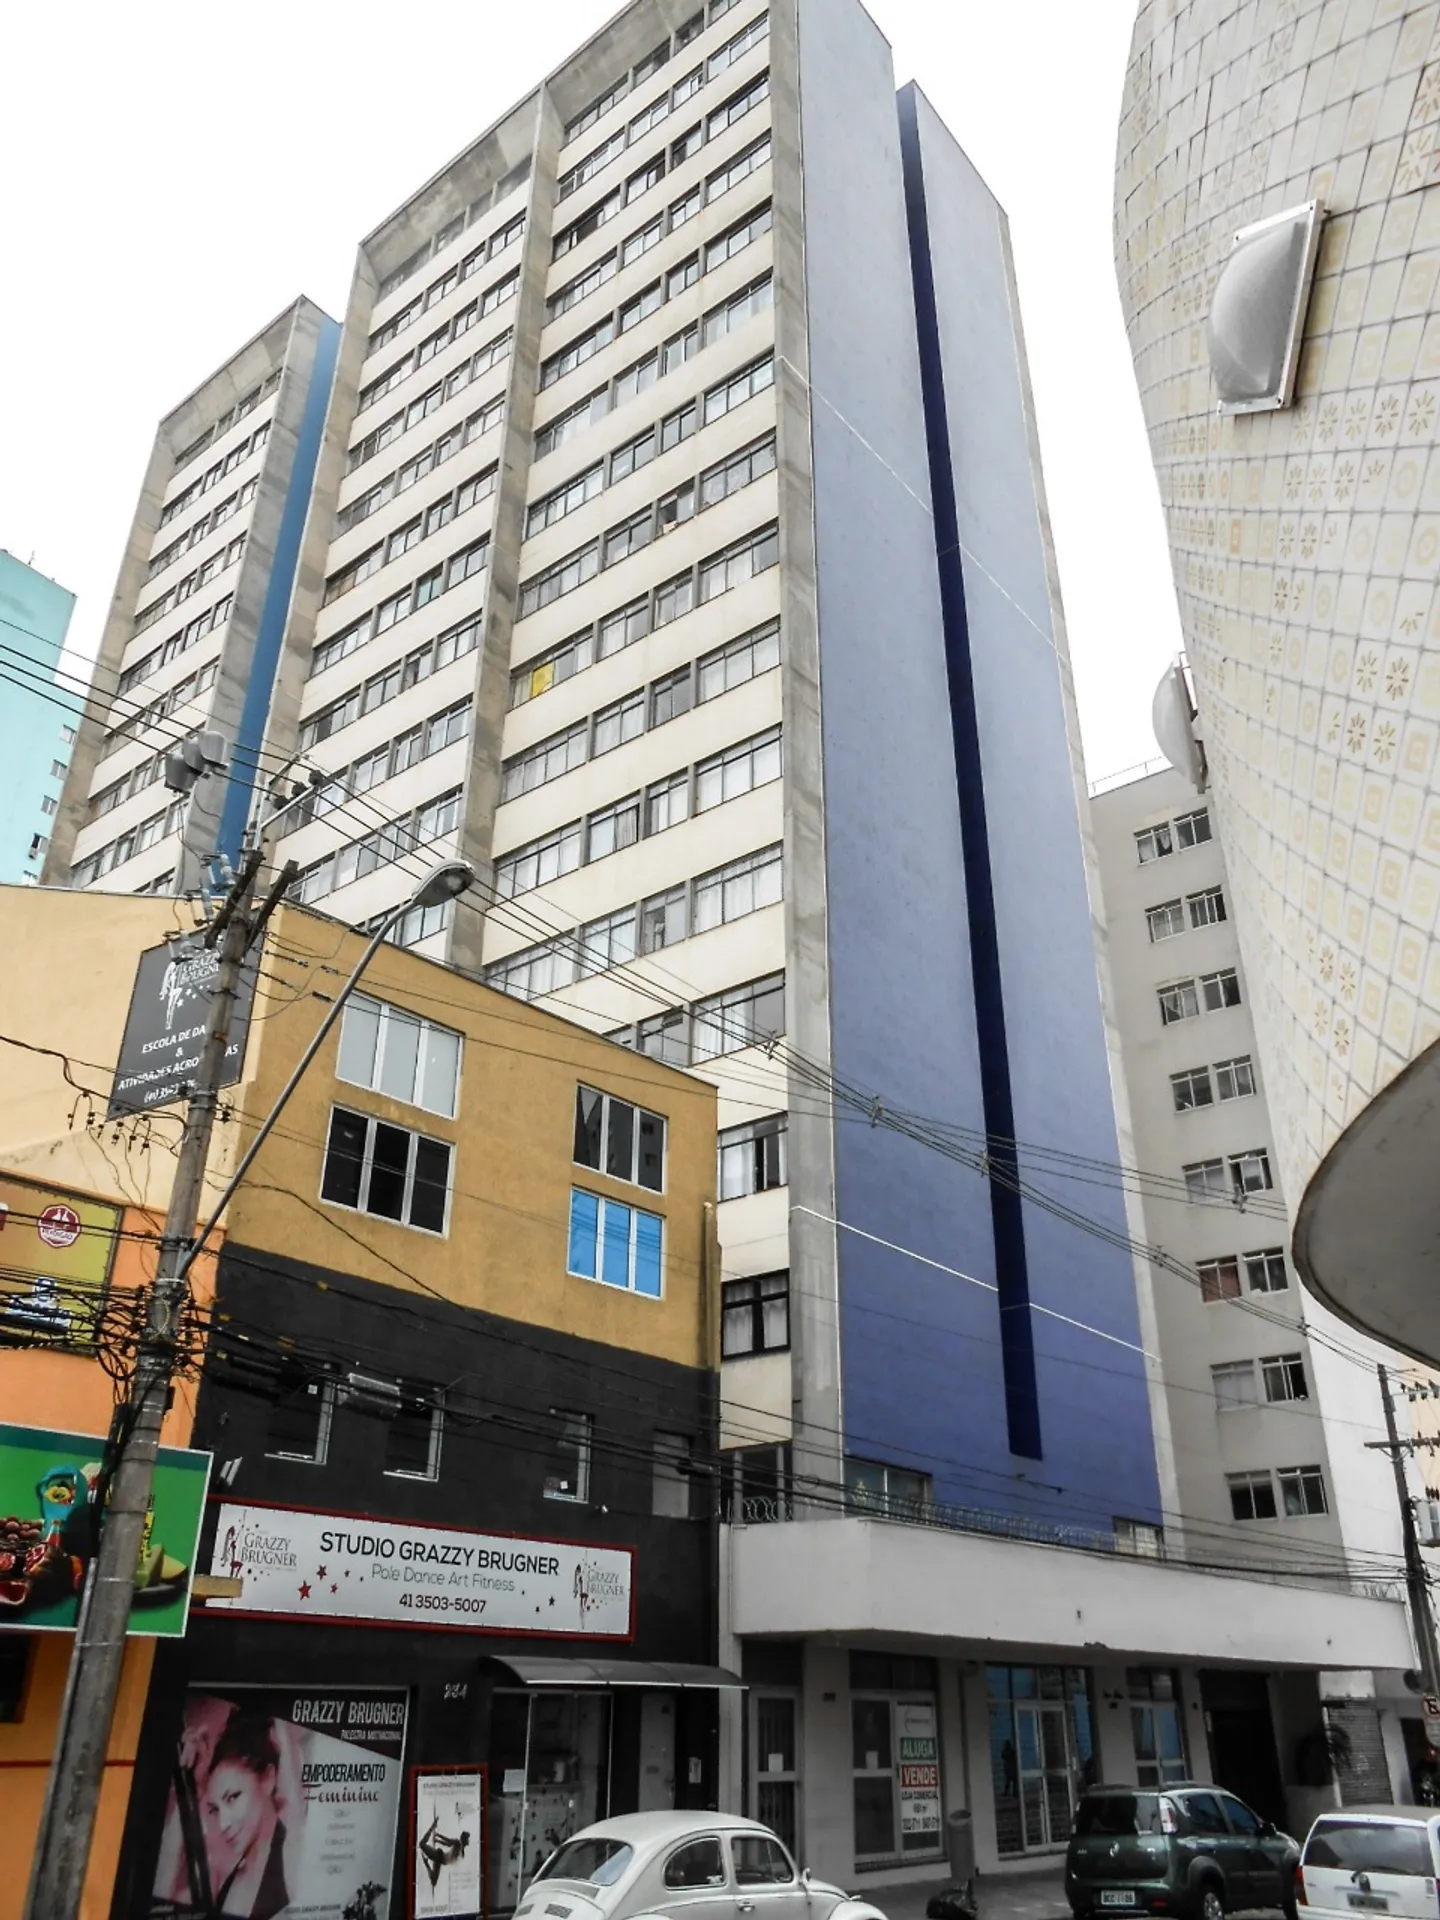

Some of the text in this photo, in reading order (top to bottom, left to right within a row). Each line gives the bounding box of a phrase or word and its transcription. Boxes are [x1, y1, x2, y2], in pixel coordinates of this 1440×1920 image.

[142, 1035, 176, 1054] ESCOLA
[178, 1028, 191, 1042] DE
[244, 1532, 292, 1551] GRAZZY
[241, 1546, 298, 1567] BRUGNER
[320, 1531, 560, 1576] STUDIO GRAZZY BRUGNER
[372, 1563, 515, 1592] Pole Dance Art Fitness
[399, 1593, 486, 1613] 41 3503-5007
[292, 1700, 404, 1725] GRAZZY BRUGNER
[903, 1740, 934, 1757] ALUGA
[301, 1764, 386, 1782] EMPODERAMENTO
[904, 1767, 936, 1785] VENDE
